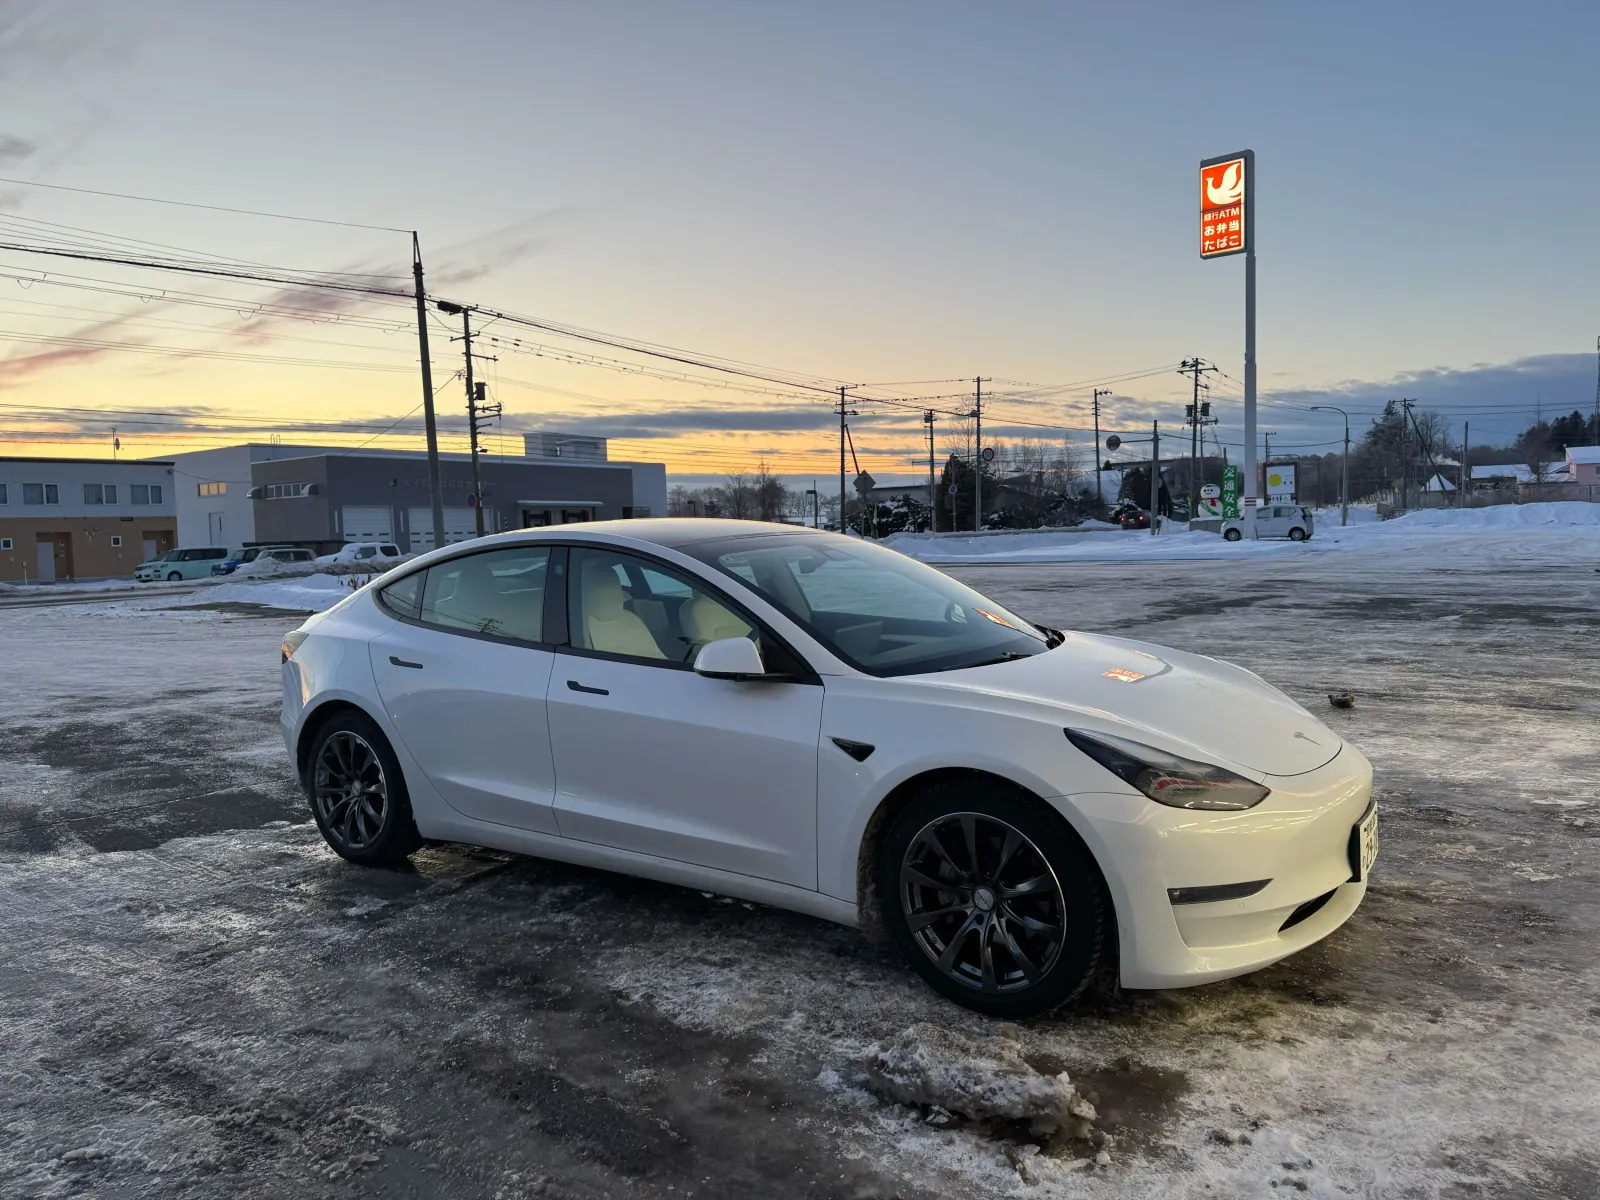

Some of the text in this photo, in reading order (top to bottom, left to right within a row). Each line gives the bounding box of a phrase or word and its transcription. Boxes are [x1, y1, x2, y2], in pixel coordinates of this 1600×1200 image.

[1203, 207, 1240, 222] 銀行ATM
[1204, 220, 1240, 237] お弁当
[1204, 235, 1240, 251] たばこ
[1223, 466, 1236, 517] 交通安全
